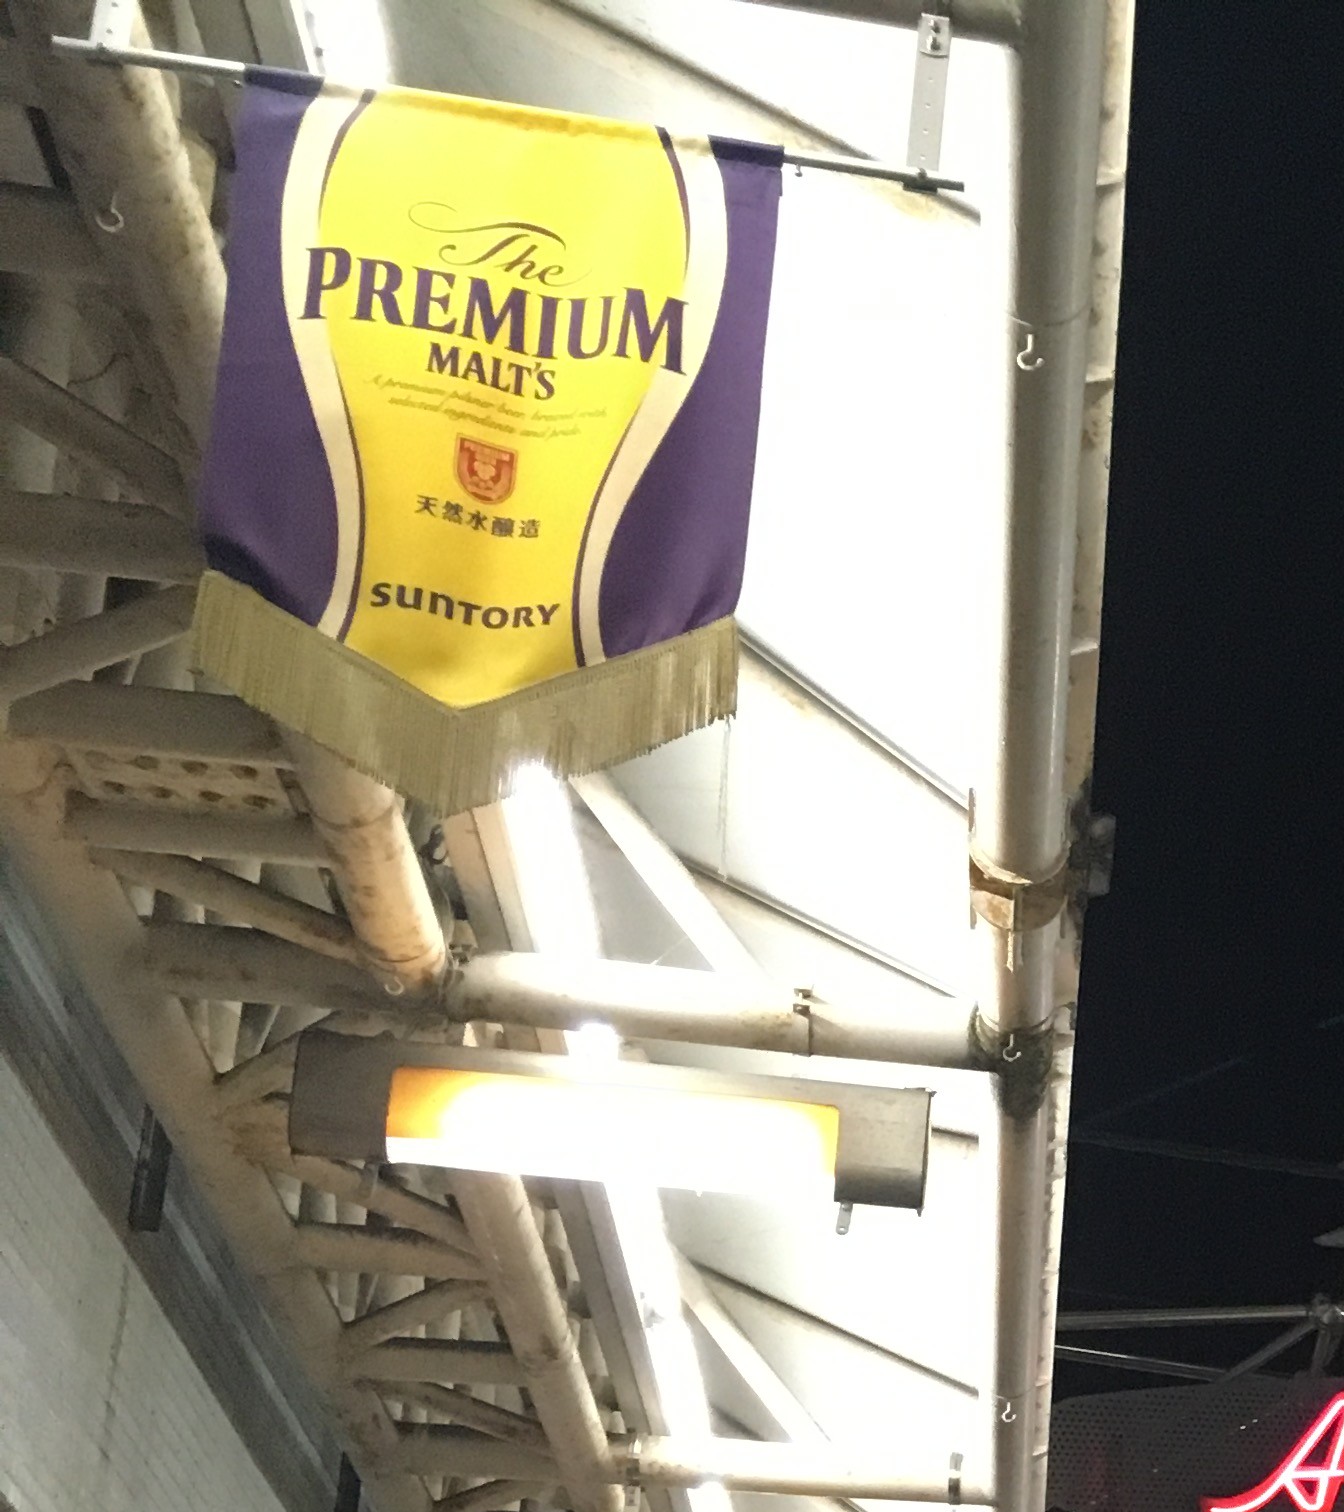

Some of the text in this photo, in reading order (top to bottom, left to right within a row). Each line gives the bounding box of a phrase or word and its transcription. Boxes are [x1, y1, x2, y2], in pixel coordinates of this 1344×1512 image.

[409, 201, 590, 288] The
[297, 246, 689, 376] PREMIUM
[426, 342, 557, 401] MALT'S
[370, 581, 560, 630] SUNTORY
